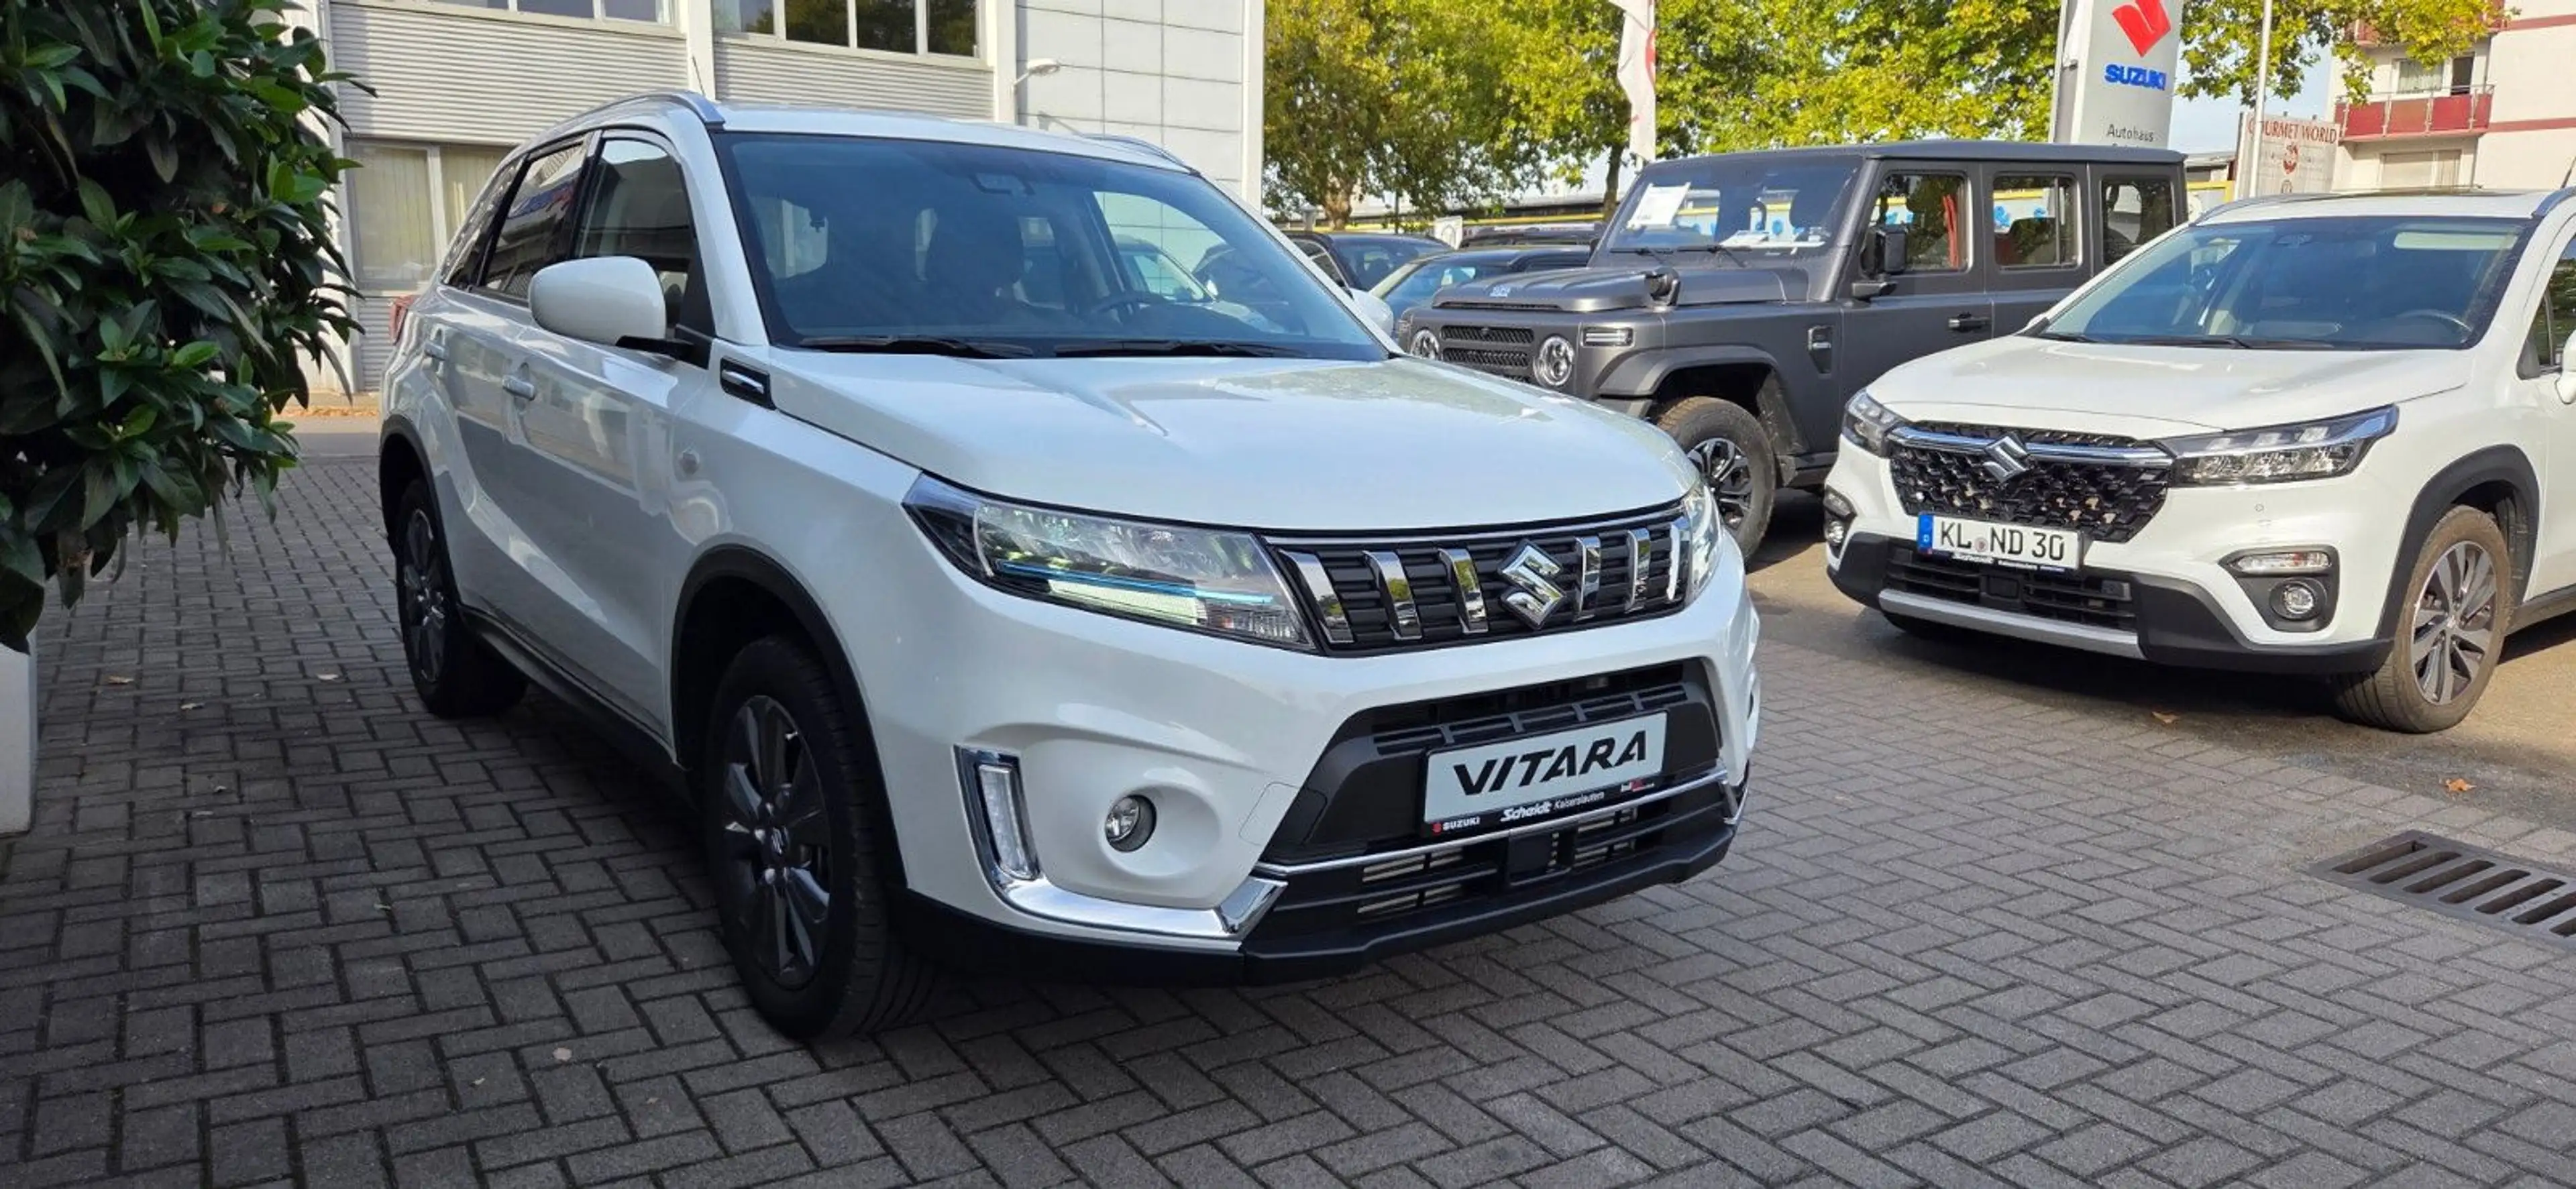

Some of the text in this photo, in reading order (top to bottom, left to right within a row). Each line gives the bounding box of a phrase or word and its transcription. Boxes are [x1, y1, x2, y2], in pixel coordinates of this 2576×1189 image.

[2104, 64, 2167, 91] SUZUKI
[2106, 123, 2154, 142] Autohaus
[2302, 125, 2337, 144] WORLD
[1941, 522, 2065, 561] KL ND 30
[1453, 730, 1646, 795] VITARA
[1442, 816, 1481, 831] SUZUKI
